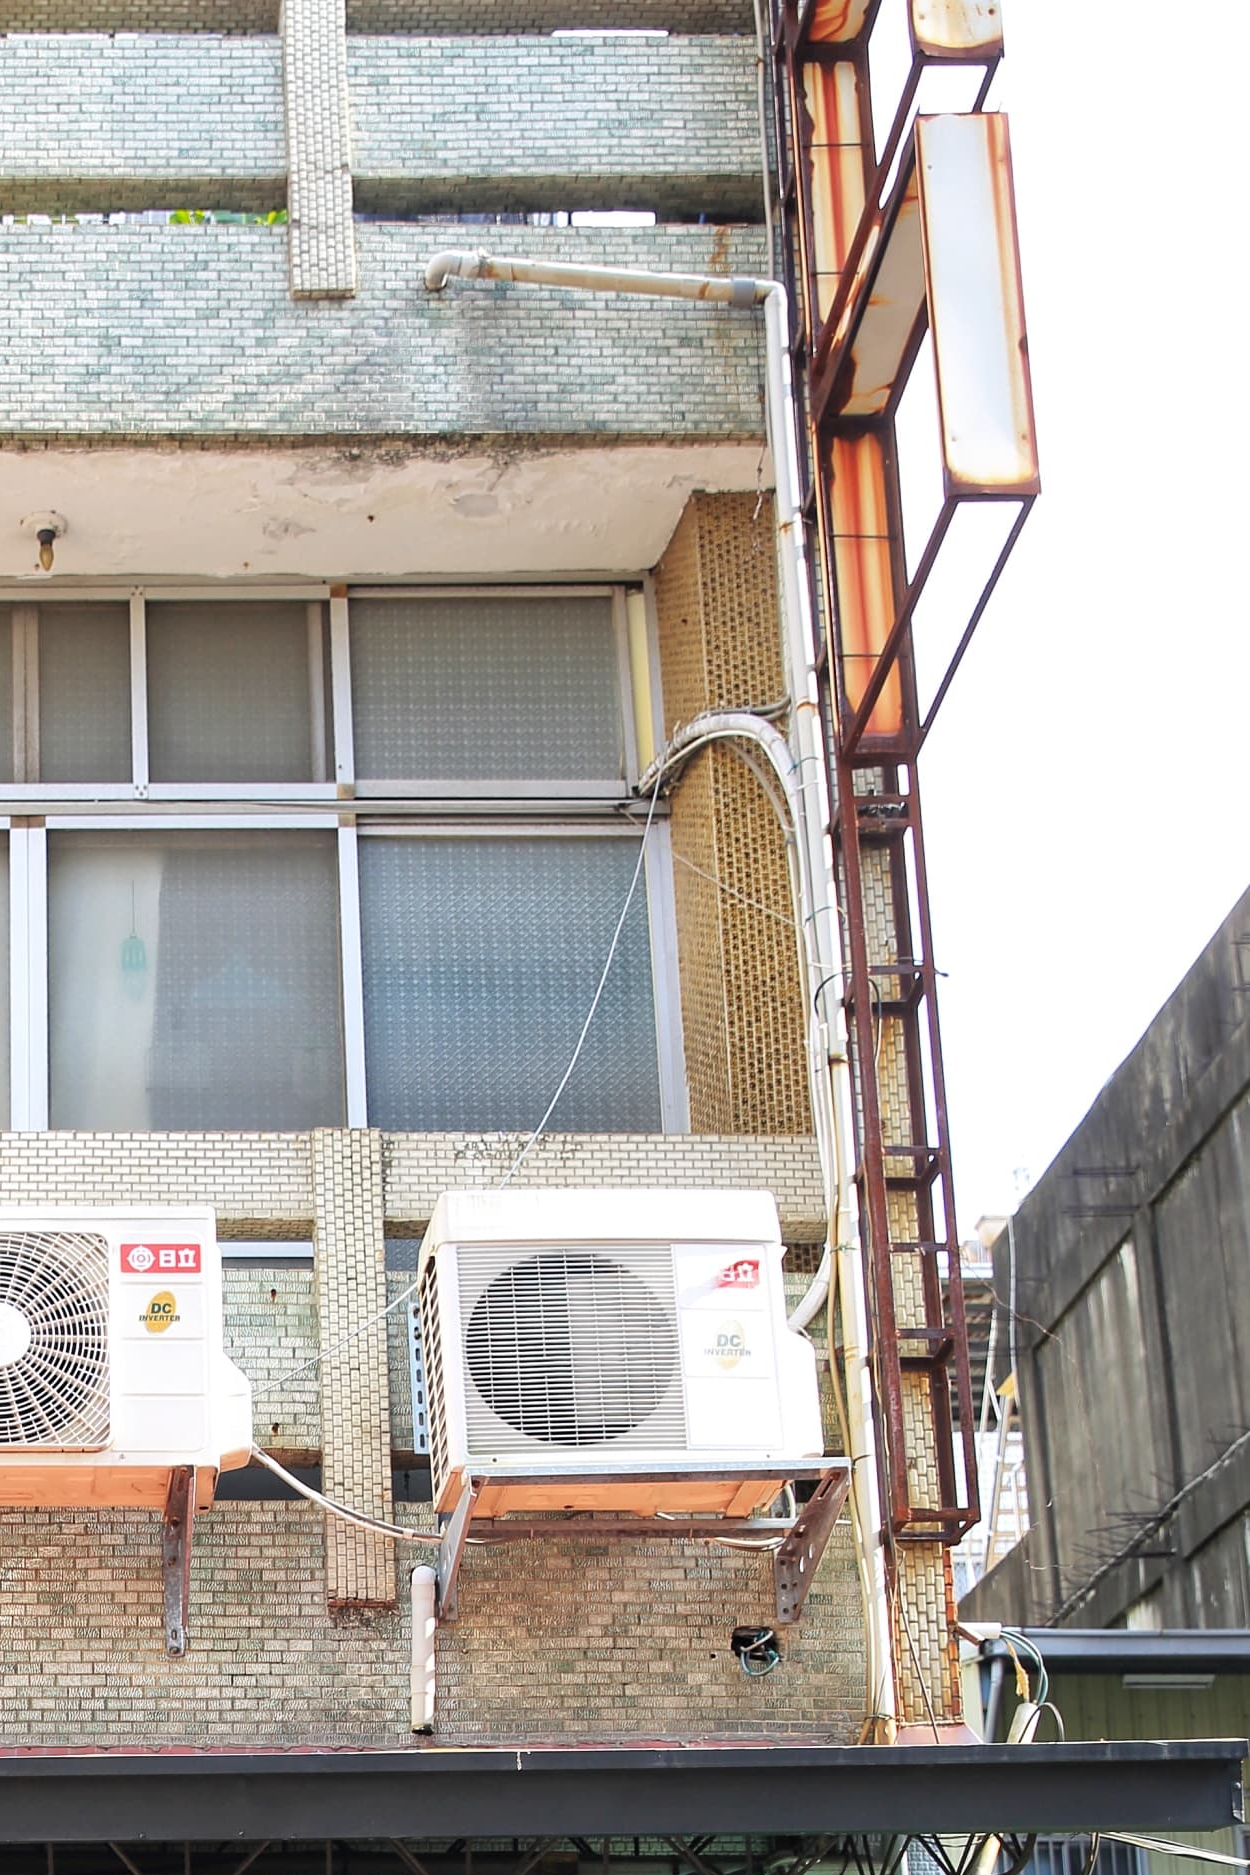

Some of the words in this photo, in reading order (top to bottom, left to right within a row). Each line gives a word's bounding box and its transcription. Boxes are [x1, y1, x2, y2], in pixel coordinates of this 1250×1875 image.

[159, 1248, 196, 1267] 日立
[151, 1303, 172, 1314] DC
[717, 1334, 741, 1347] DC
